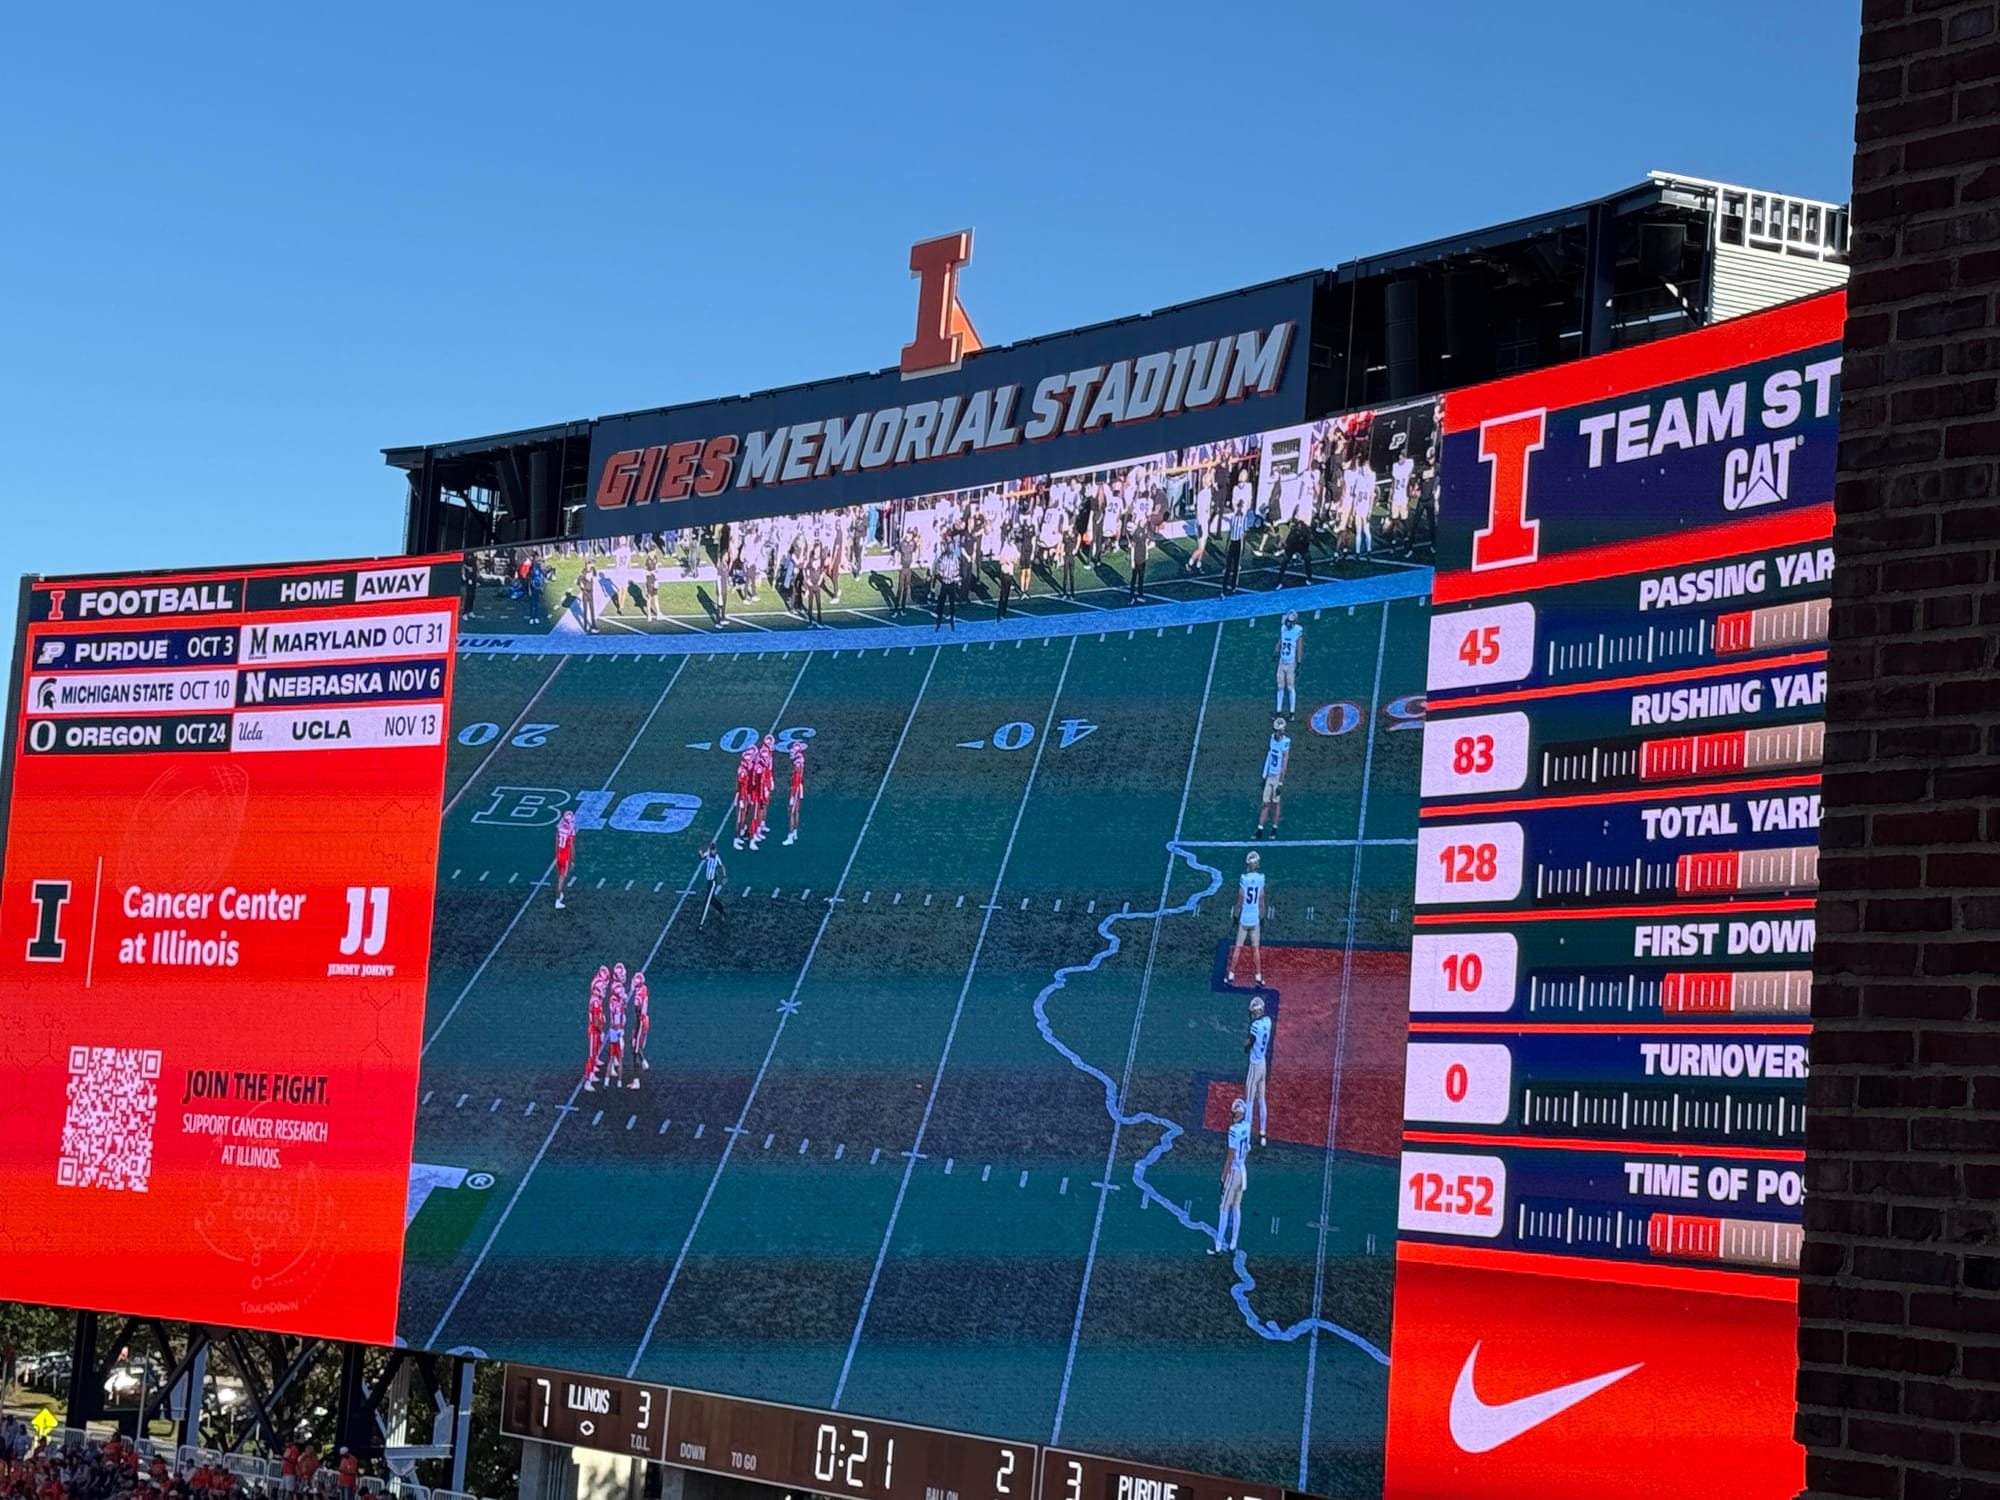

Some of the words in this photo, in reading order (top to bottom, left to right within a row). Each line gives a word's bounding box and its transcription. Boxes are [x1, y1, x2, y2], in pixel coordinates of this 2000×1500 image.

[901, 227, 974, 382] I
[596, 434, 740, 511] GIES
[736, 384, 1021, 491] MEMORIAL
[1024, 320, 1296, 442] STADIUM
[1579, 381, 1747, 469] TEAM
[1761, 356, 1844, 429] ST
[1472, 407, 1547, 572] I
[280, 578, 344, 603] HOME
[361, 573, 426, 596] AWAY
[1639, 551, 1766, 611] PASSING
[79, 585, 233, 617] FOOTBALL
[37, 641, 65, 664] P
[74, 640, 168, 663] PURDUE
[187, 637, 220, 659] OCT
[223, 635, 234, 656] 3
[249, 627, 269, 655] M
[272, 628, 387, 654] MARYLAND
[392, 624, 423, 645] OCT
[427, 623, 443, 644] 31
[1458, 626, 1501, 666] 45
[61, 684, 131, 705] MICHIGAN
[133, 683, 174, 702] STATE
[180, 680, 209, 700] OCT
[214, 679, 230, 699] 10
[244, 671, 266, 703] N
[268, 672, 383, 698] NEBRASKA
[388, 668, 427, 692] NOV
[429, 668, 440, 690] 6
[1630, 679, 1761, 726] RUSHING
[30, 720, 57, 752] O
[65, 725, 162, 747] OREGON
[175, 724, 206, 744] OCT
[208, 722, 226, 744] 24
[292, 720, 352, 741] UCLA
[384, 715, 416, 737] NOV
[421, 714, 436, 736] 13
[1452, 734, 1495, 775] 83
[1641, 803, 1738, 840] TOTAL
[1439, 843, 1498, 883] 128
[123, 885, 214, 919] Cancer
[218, 886, 307, 921] Center
[1246, 886, 1259, 904] 51
[25, 879, 72, 962] I
[339, 886, 390, 956] JJ
[118, 932, 147, 964] at
[152, 929, 240, 967] Illinois
[1634, 924, 1719, 957] FIRST
[327, 963, 360, 977] JIMMY
[361, 963, 395, 977] JOHN'S
[1442, 953, 1484, 992] 10
[182, 1069, 229, 1104] JOIN
[234, 1072, 268, 1101] THE
[272, 1074, 330, 1105] FIGHT.
[1444, 1064, 1468, 1103] 0
[182, 1113, 231, 1135] SUPPORT
[232, 1116, 273, 1139] CANCER
[275, 1119, 329, 1143] RESEARCH
[221, 1145, 235, 1165] AT
[236, 1146, 282, 1169] ILLINOIS.
[1409, 1172, 1495, 1216] 12:52
[1624, 1162, 1700, 1198] TIME
[1707, 1168, 1748, 1200] OF
[1757, 1169, 1807, 1205] PO
[537, 1378, 551, 1428] 7
[568, 1384, 610, 1414] ILLINOIS
[637, 1391, 651, 1429] 3
[680, 1442, 706, 1462] DOWN
[731, 1451, 743, 1468] TO
[743, 1453, 757, 1471] GO
[815, 1424, 894, 1489] 0:21
[996, 1450, 1015, 1494] 2
[1066, 1461, 1082, 1500] 3
[1118, 1475, 1178, 1500] PURDUE
